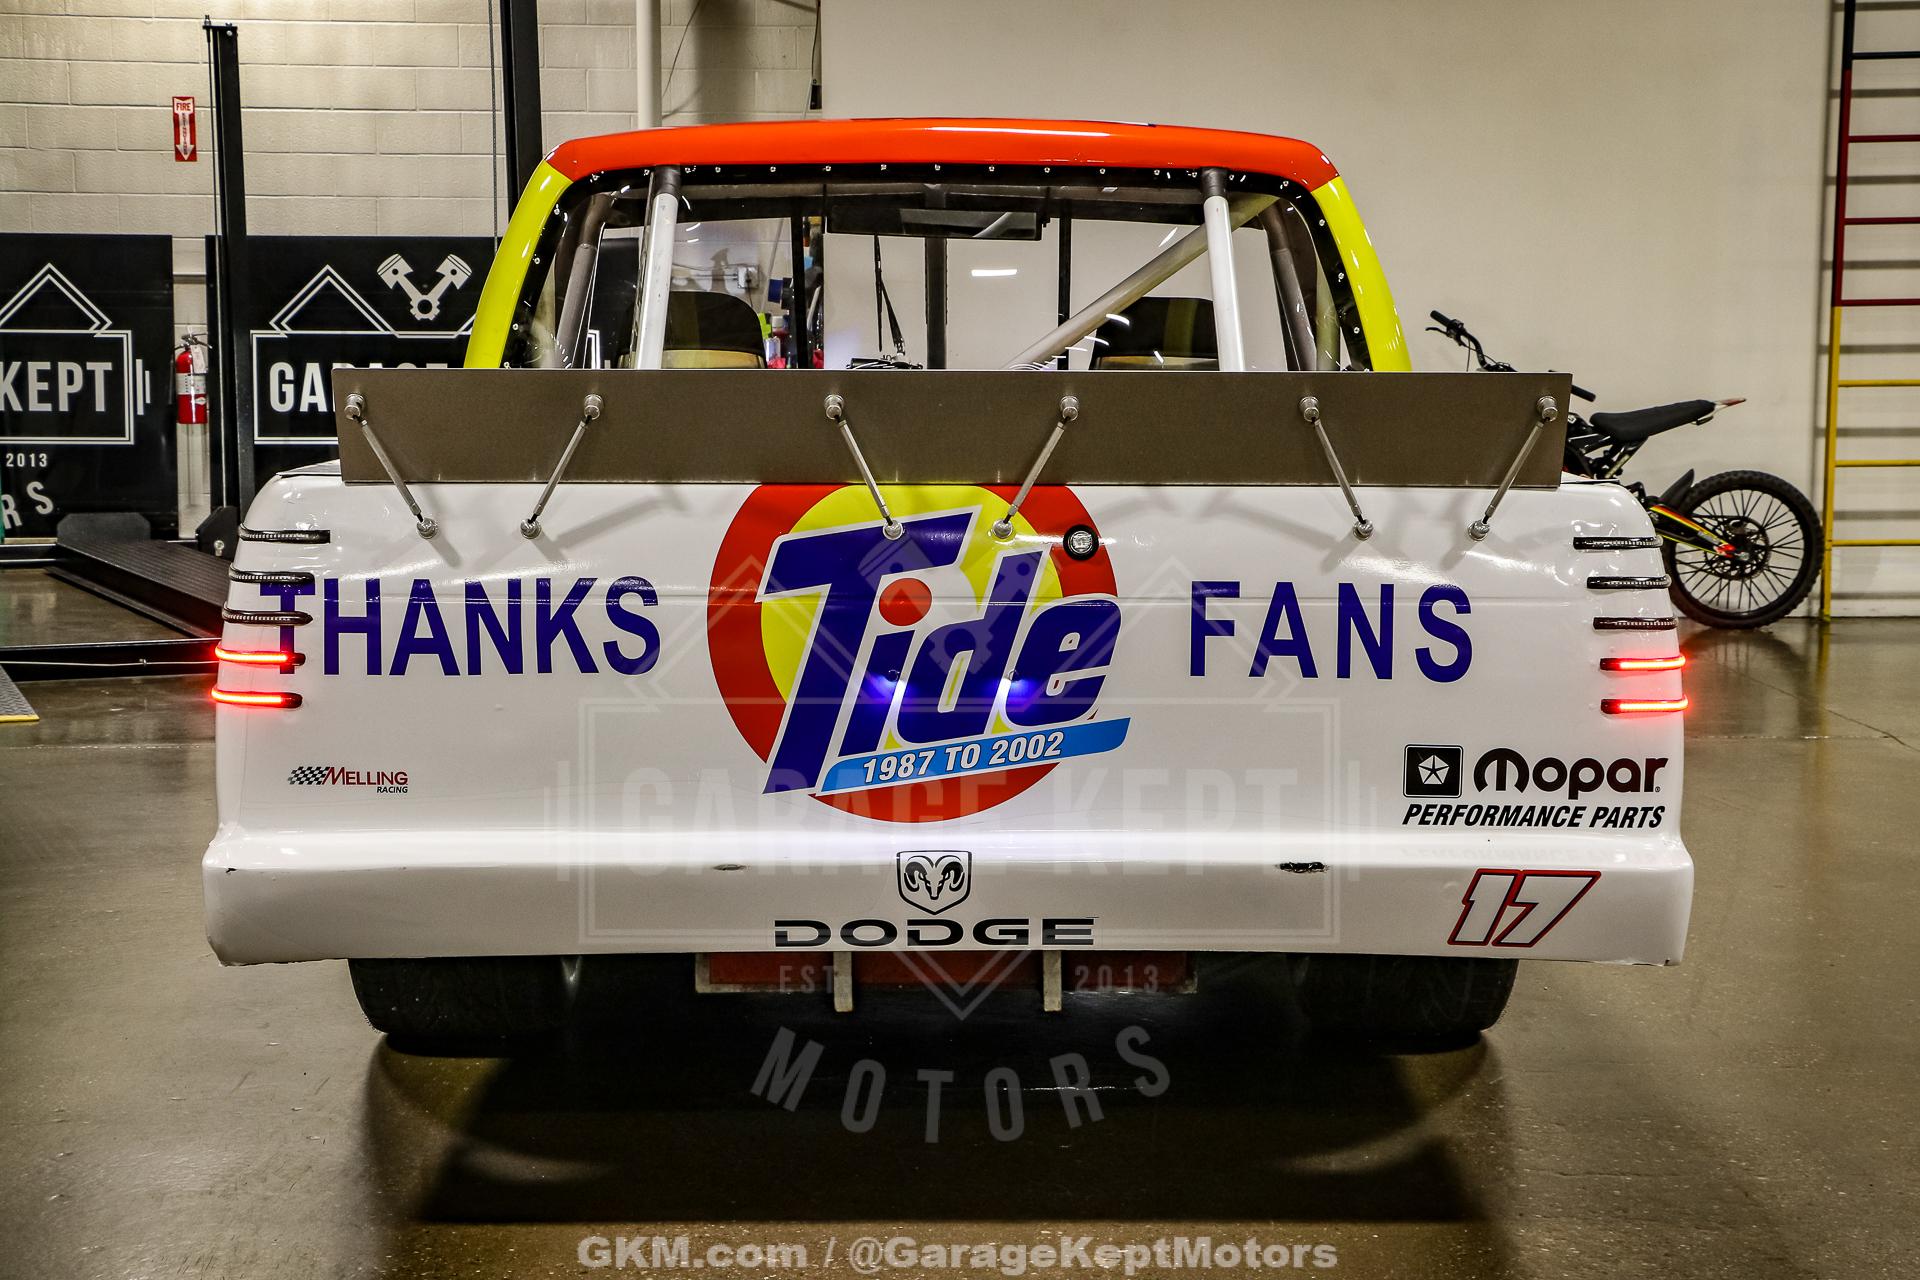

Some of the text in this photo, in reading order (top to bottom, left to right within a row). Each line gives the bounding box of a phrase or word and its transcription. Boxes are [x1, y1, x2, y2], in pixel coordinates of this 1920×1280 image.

[176, 102, 191, 111] FIRE
[0, 361, 113, 412] KEPT
[6, 453, 48, 468] 2013
[259, 576, 661, 676] THANKS
[1190, 581, 1473, 683] FANS
[756, 505, 1122, 795] Tide
[322, 766, 408, 785] MELLING
[863, 731, 1064, 784] 1987 TO 2002
[376, 786, 408, 794] RACING
[1402, 804, 1666, 828] PERFORMANCE PARTS
[1447, 868, 1602, 947] 17
[774, 917, 1096, 948] DODGE
